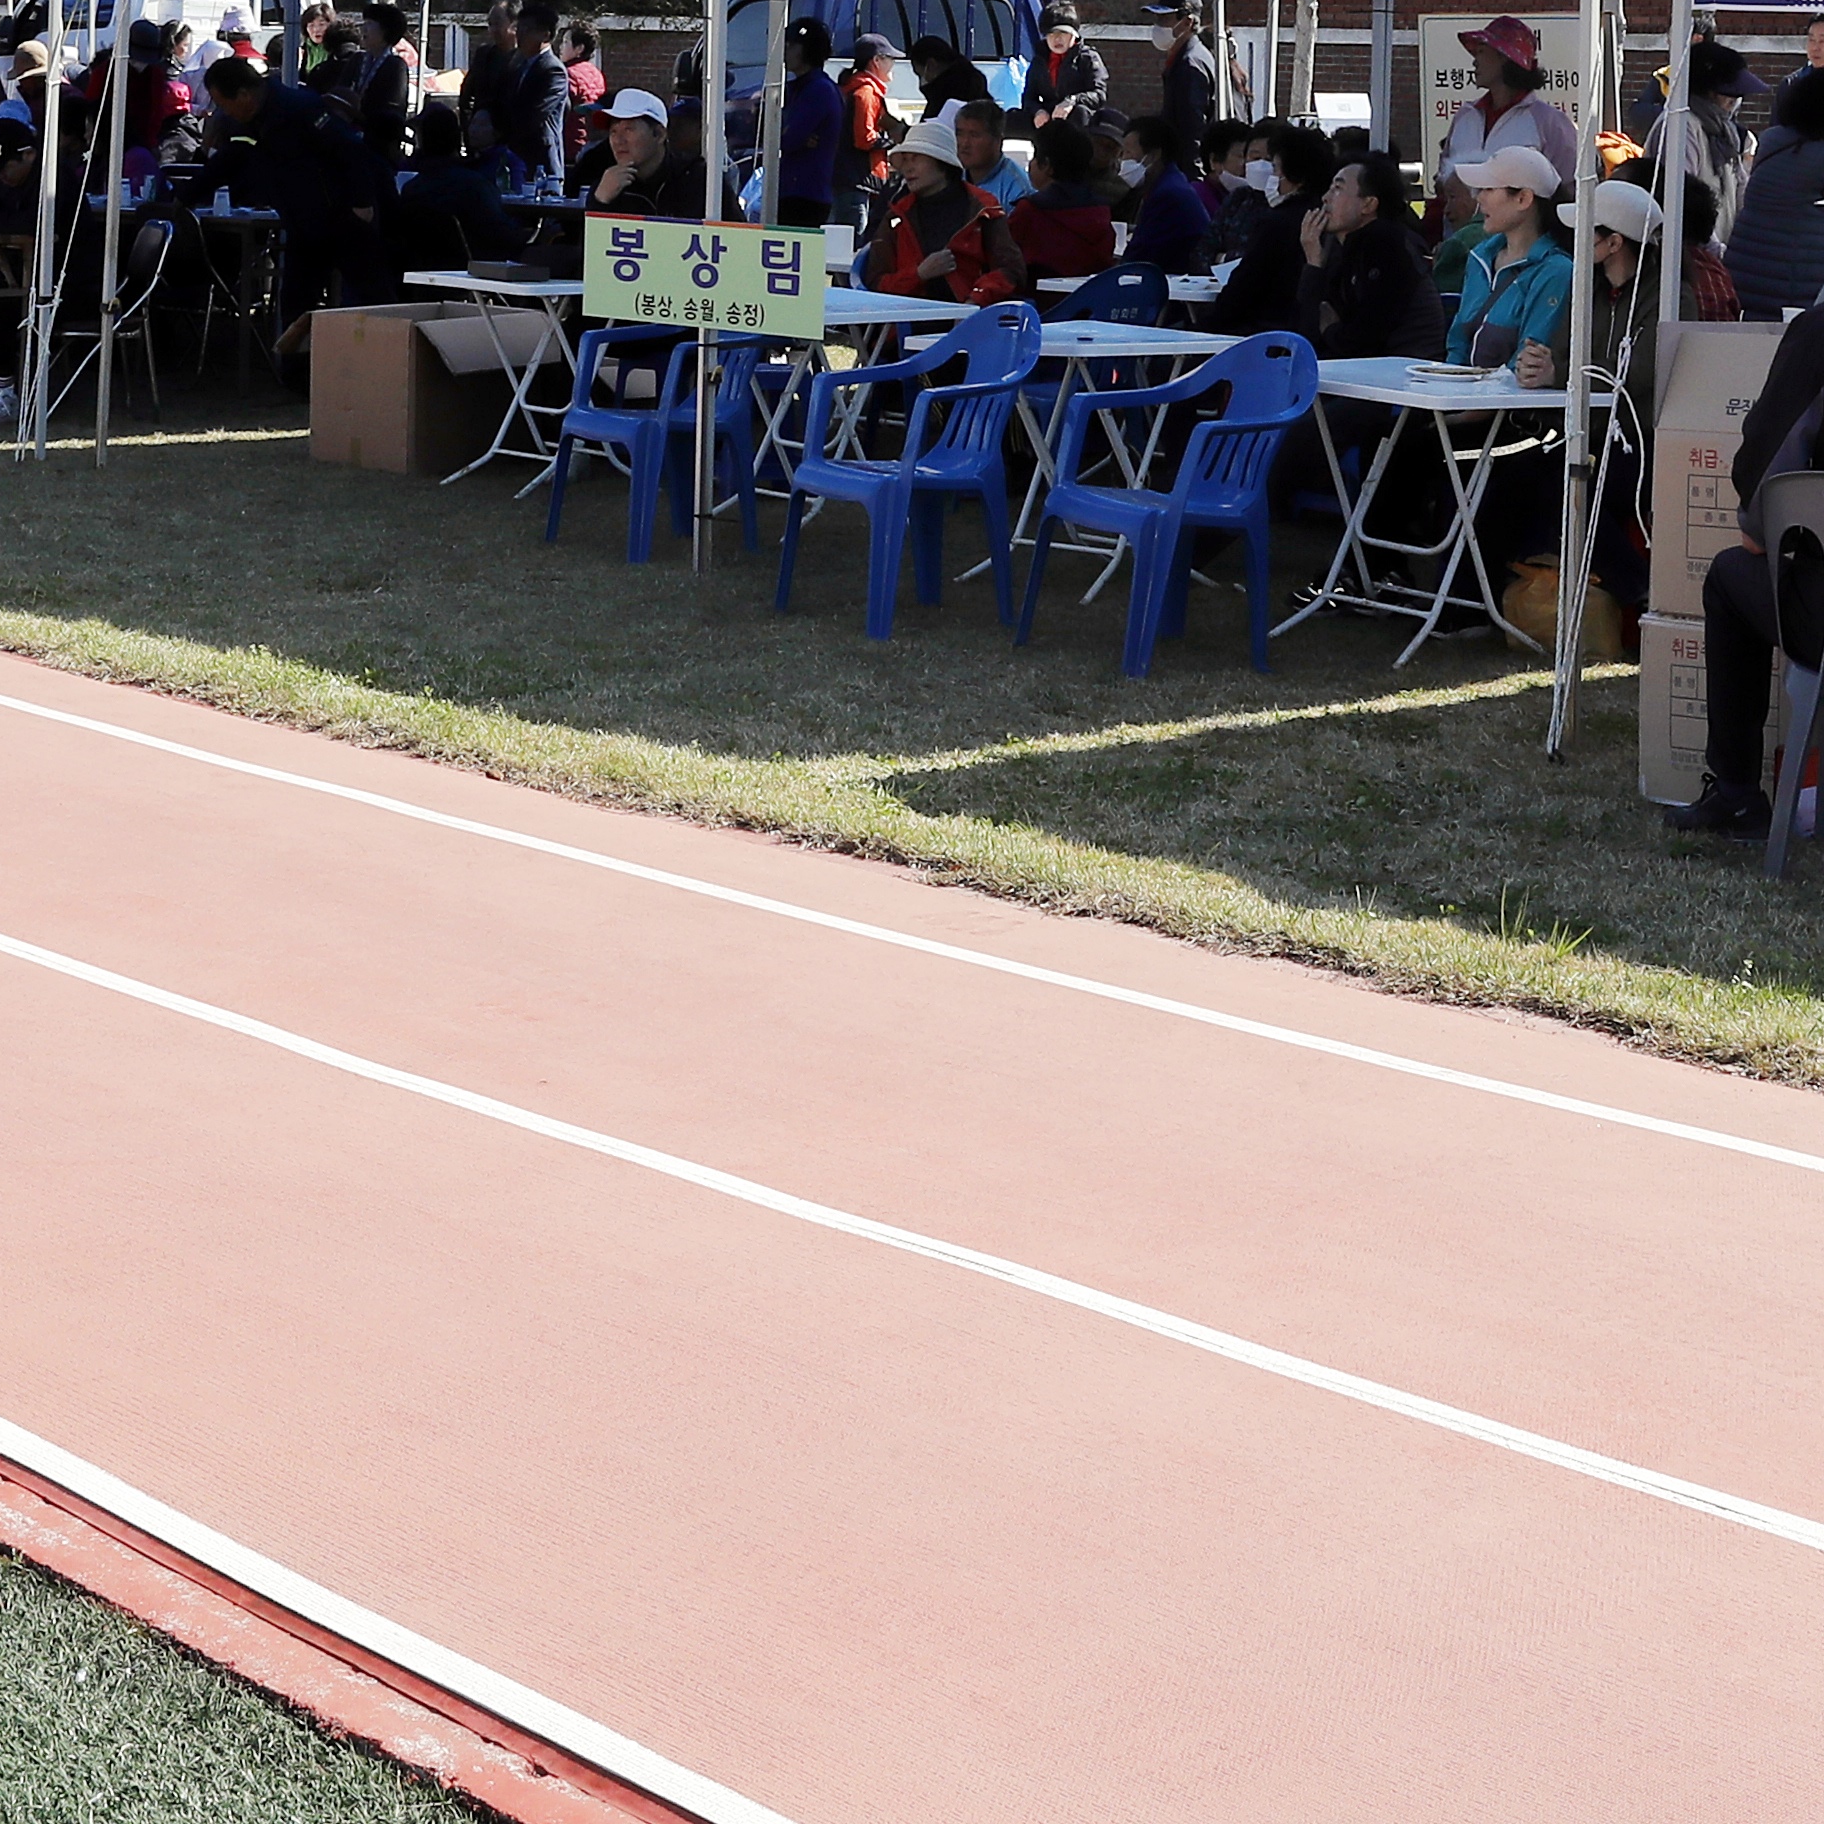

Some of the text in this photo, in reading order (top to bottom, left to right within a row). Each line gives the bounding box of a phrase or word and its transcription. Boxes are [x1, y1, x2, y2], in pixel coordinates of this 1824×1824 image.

[635, 292, 765, 328] (봉상, 송월, 송정)
